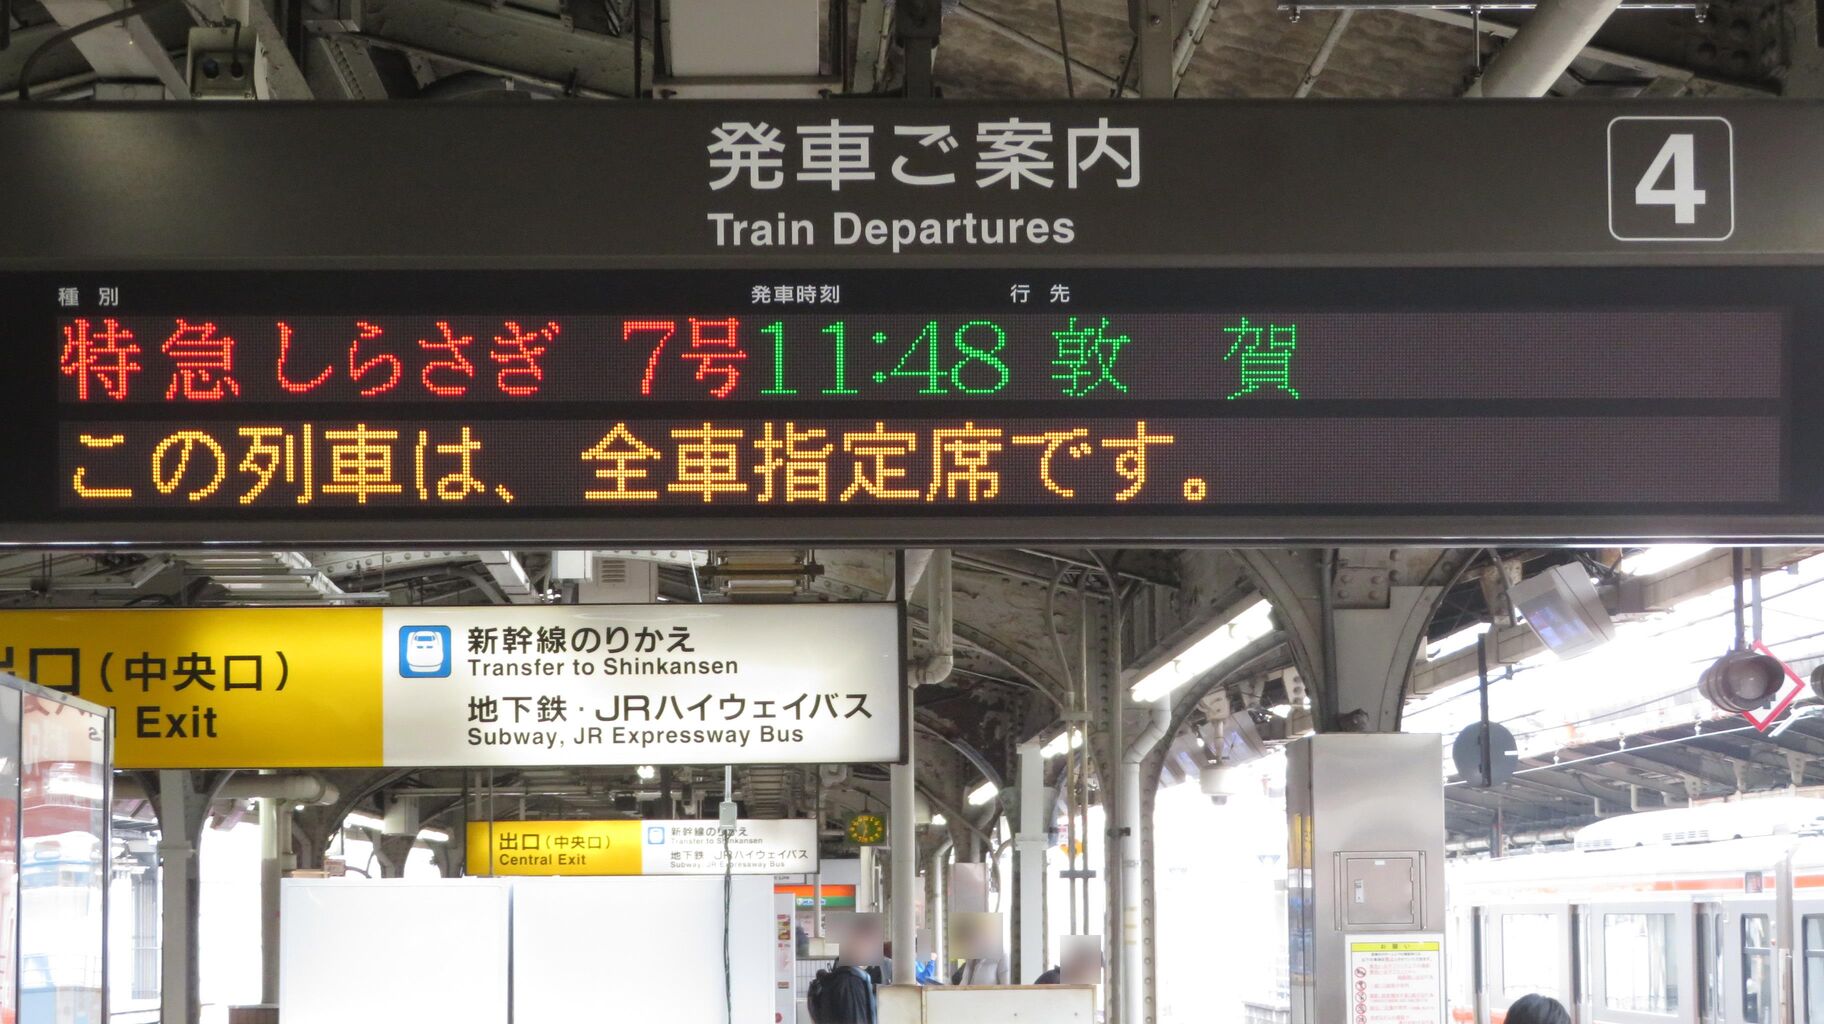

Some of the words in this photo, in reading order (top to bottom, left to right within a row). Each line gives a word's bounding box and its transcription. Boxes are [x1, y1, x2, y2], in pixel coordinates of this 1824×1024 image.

[706, 117, 1141, 191] 発車ご案内
[1635, 133, 1706, 224] 4
[707, 212, 814, 246] Train
[833, 211, 1075, 253] Departures
[751, 284, 840, 304] 発車時刻
[760, 321, 1010, 394] 11:48
[467, 625, 696, 655] 新幹線のりかえ
[467, 658, 565, 676] Transfer
[573, 659, 595, 676] to
[603, 657, 738, 676] Shinkansen
[136, 705, 218, 739] Exit
[467, 727, 564, 749] Subway,
[574, 727, 602, 745] JR
[612, 726, 750, 748] Expressway
[760, 725, 804, 743] Bus
[499, 853, 552, 866] Central
[558, 853, 587, 866] Exit
[719, 860, 766, 868] Epressway
